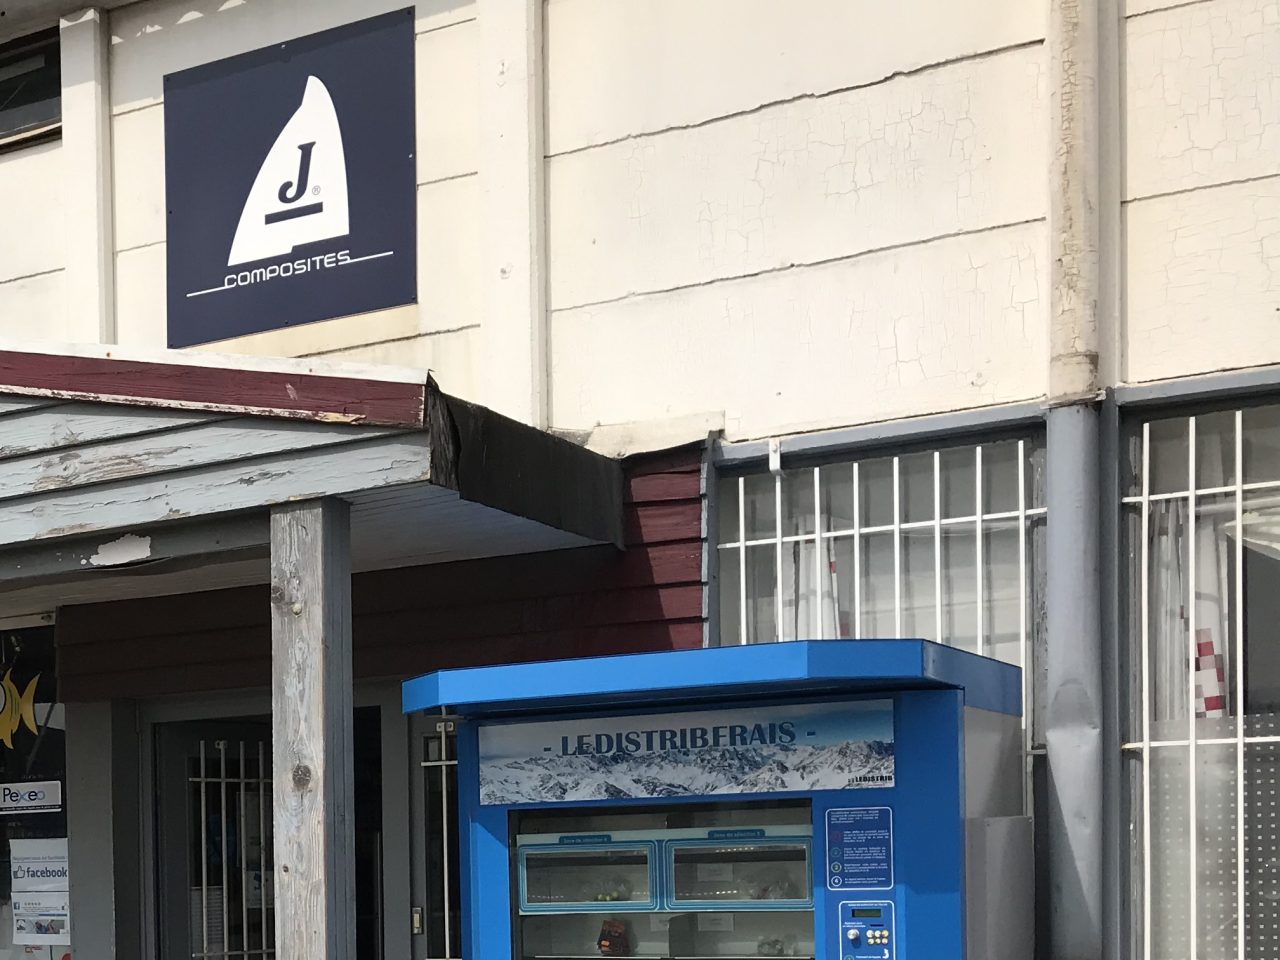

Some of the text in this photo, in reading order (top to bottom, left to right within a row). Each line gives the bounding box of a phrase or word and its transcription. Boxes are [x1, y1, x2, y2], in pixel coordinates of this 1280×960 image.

[278, 141, 317, 204] J
[224, 250, 350, 288] COMPOSITES
[26, 866, 67, 878] facebook
